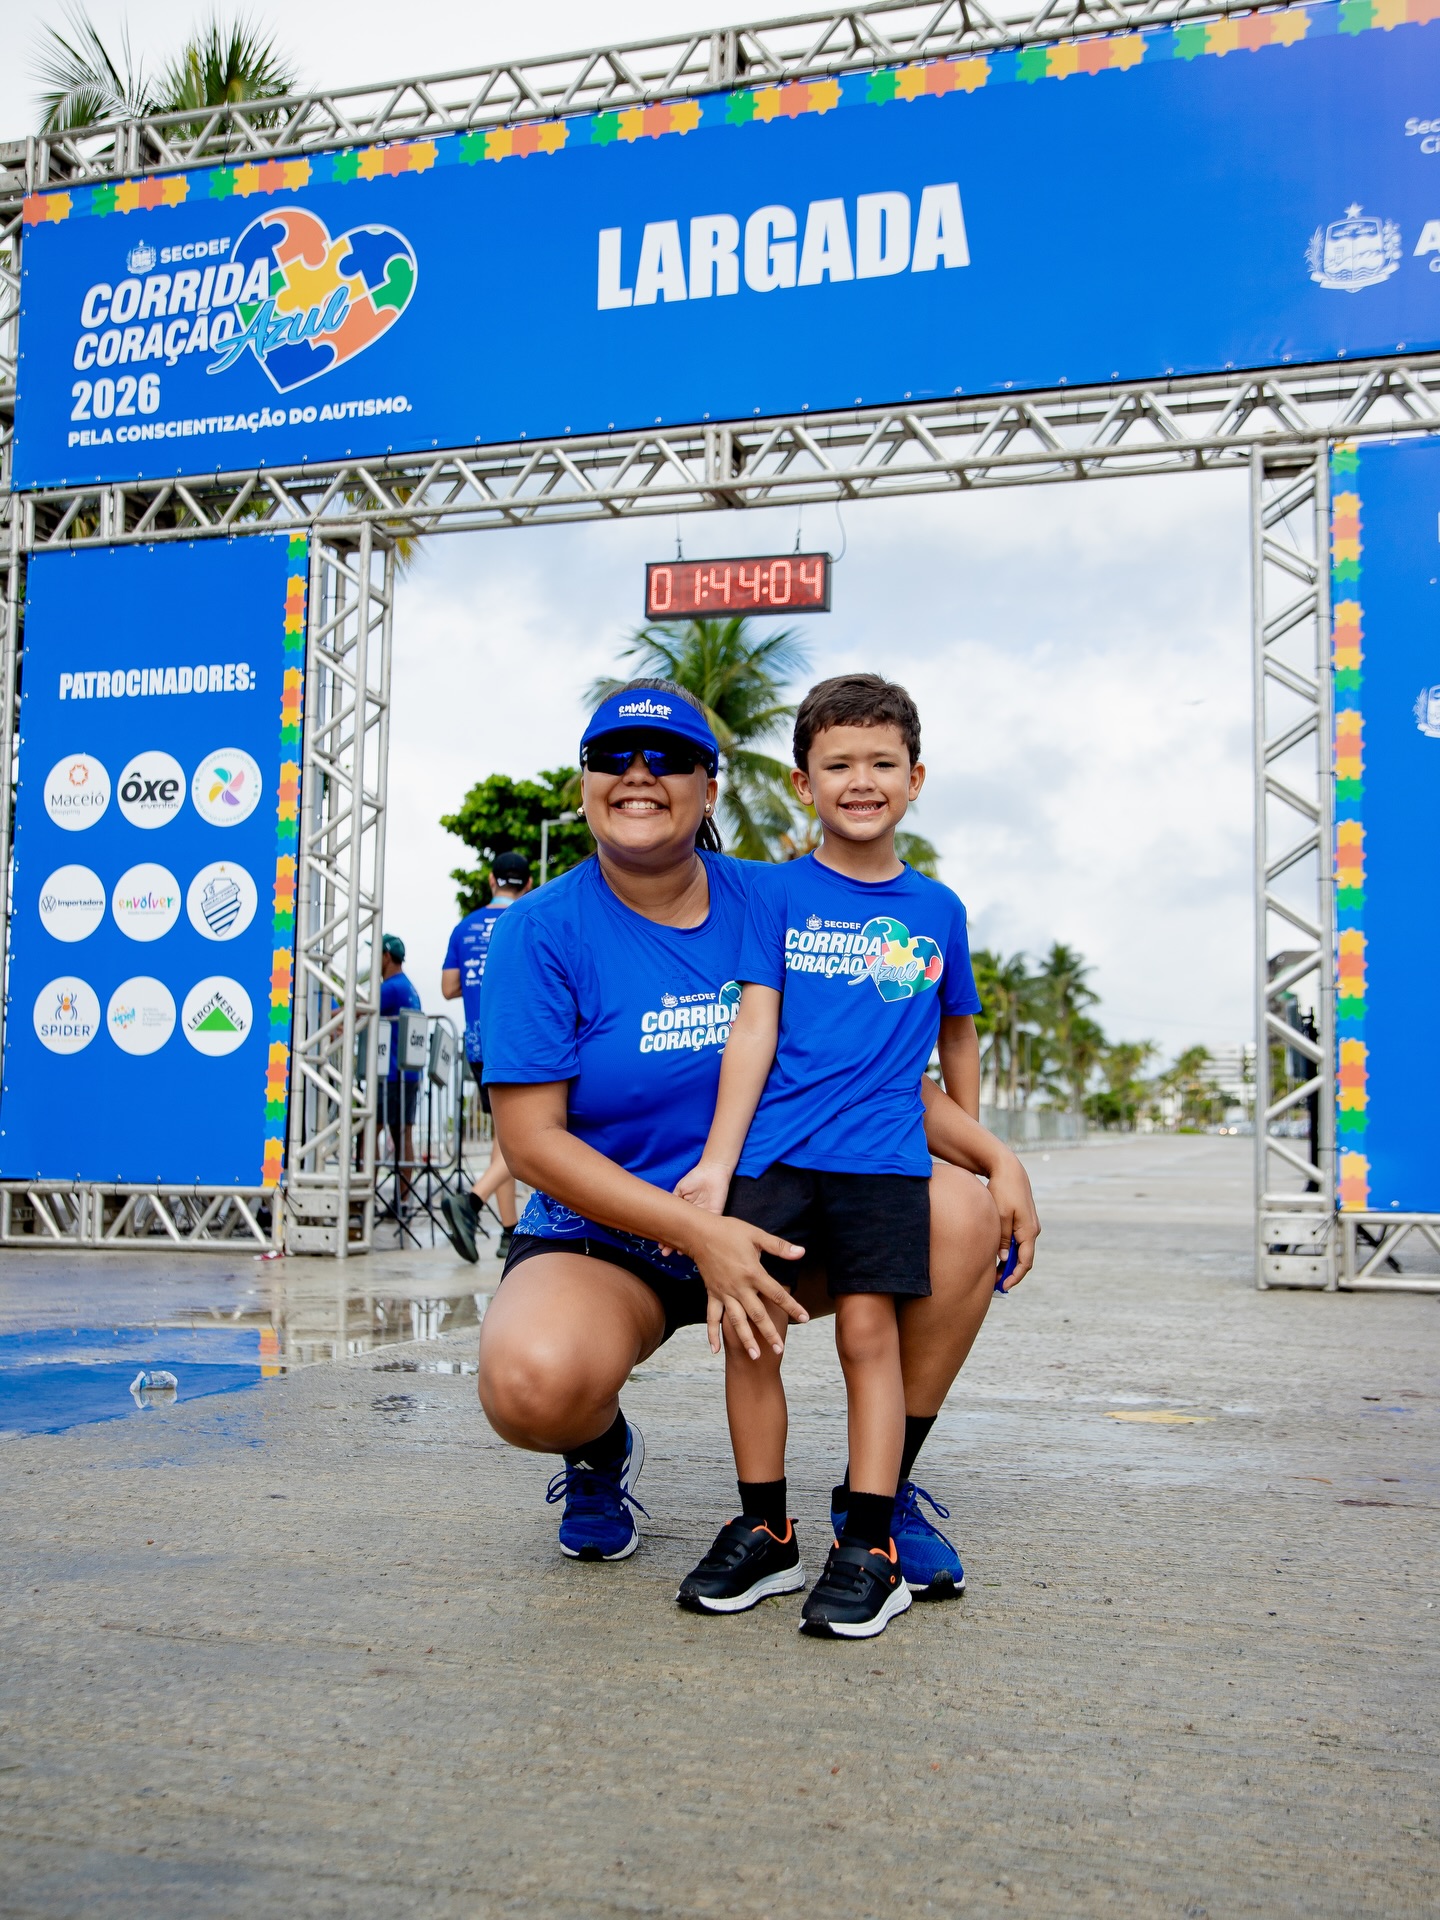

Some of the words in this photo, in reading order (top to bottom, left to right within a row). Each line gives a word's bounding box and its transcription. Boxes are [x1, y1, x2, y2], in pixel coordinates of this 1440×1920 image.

[160, 237, 230, 264] SECDEF
[597, 181, 971, 311] LARGADA
[80, 256, 270, 329] CORRIDA
[73, 306, 236, 371] CORAÇÃO
[206, 285, 351, 374] Azul
[70, 372, 161, 421] 2026
[67, 424, 114, 448] PELA
[117, 407, 287, 443] CONSCIENTIZAÇÃO
[289, 406, 318, 425] DO
[319, 395, 413, 421] AUTISMO.
[59, 662, 256, 700] PATROCINADORES:
[51, 791, 104, 807] Maceió
[121, 772, 180, 803] ôxe
[140, 801, 179, 810] eventos
[824, 920, 862, 930] SECDEF
[785, 928, 882, 956] CORRIDA
[784, 951, 864, 978] CORAÇÃO
[847, 955, 918, 986] Azul
[187, 998, 216, 1031] LEROY
[213, 991, 247, 1032] MERLIN
[679, 992, 717, 1004] SECDEF
[41, 1024, 91, 1037] SPIDER
[639, 1022, 731, 1053] CORAÇÃO
